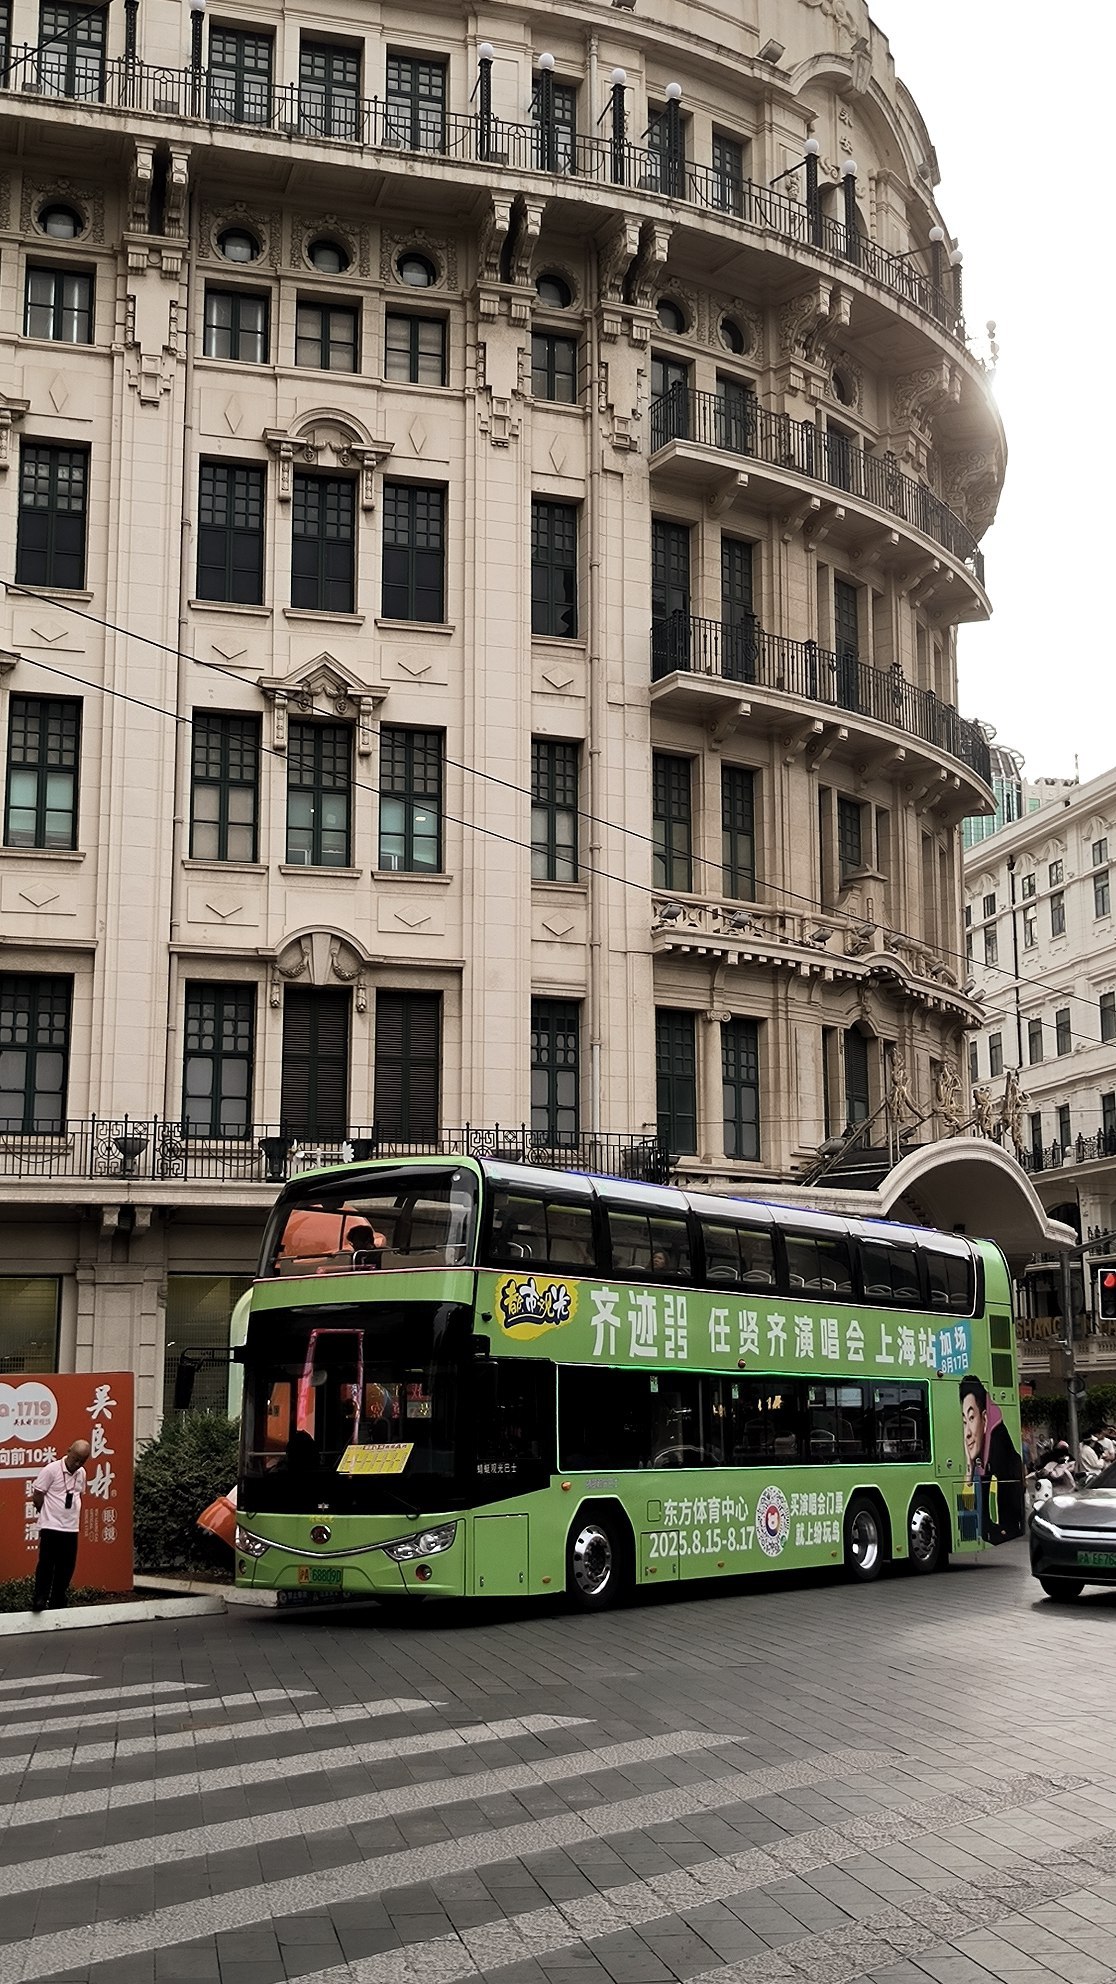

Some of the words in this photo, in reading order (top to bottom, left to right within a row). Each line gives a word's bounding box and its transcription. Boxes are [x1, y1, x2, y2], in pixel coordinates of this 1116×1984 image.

[503, 1277, 570, 1320] 都市观光
[590, 1287, 658, 1358] 齐迹
[708, 1307, 865, 1362] 任贤齐演唱会
[875, 1323, 937, 1368] 上海站
[939, 1326, 967, 1356] 加场
[941, 1352, 969, 1375] 8月17日
[86, 1384, 117, 1500] 吴良材
[663, 1496, 749, 1527] 东方体育中心
[790, 1491, 844, 1517] 买演唱会门票
[649, 1526, 755, 1558] 2025.8.15-8.17
